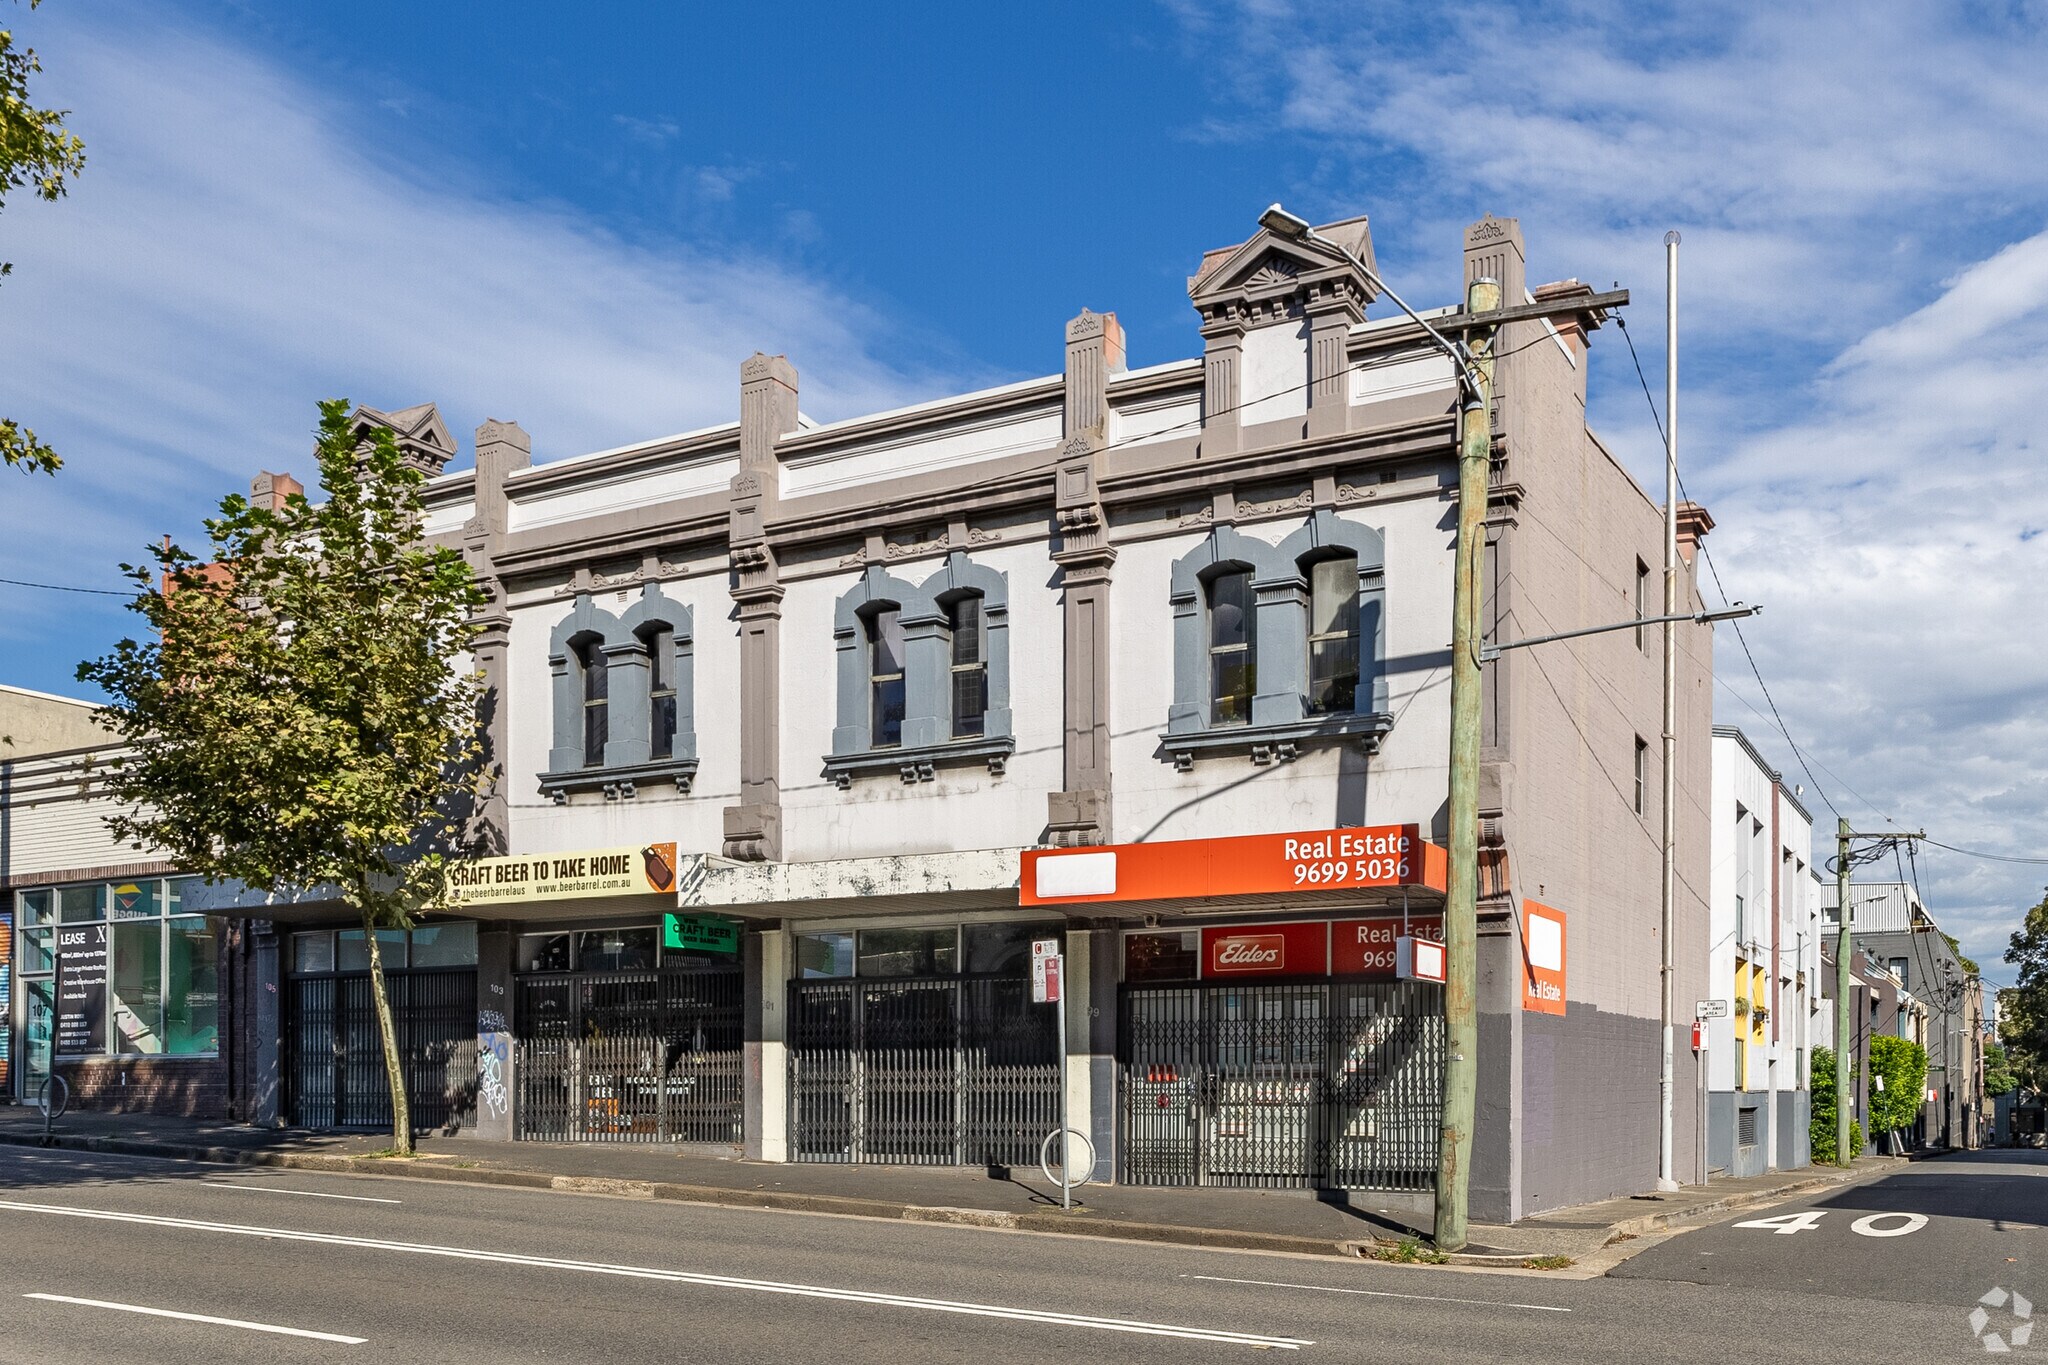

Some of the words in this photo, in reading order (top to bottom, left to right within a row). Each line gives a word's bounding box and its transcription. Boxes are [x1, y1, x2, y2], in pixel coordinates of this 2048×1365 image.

[1284, 835, 1333, 860] Real
[1340, 832, 1410, 857] Estate
[452, 865, 492, 886] CRAFT
[496, 862, 529, 883] BEER
[533, 861, 549, 880] TO
[553, 858, 586, 879] TAKE
[590, 854, 630, 876] HOME
[1294, 861, 1348, 885] 9699
[1355, 857, 1410, 881] 5036
[463, 885, 525, 899] thebeerbarrelaus
[536, 878, 631, 894] www.beerbarrel.com.au
[60, 932, 86, 946] LEASE
[672, 923, 704, 936] CRAFT
[708, 926, 731, 939] BEER
[1357, 924, 1397, 944] Real
[1219, 943, 1279, 964] Elders
[265, 982, 277, 993] 105
[490, 983, 504, 995] 103
[1528, 979, 1542, 999] Real
[1543, 980, 1561, 1002] Estate
[32, 1004, 48, 1017] 107
[1731, 1211, 1930, 1237] 40
